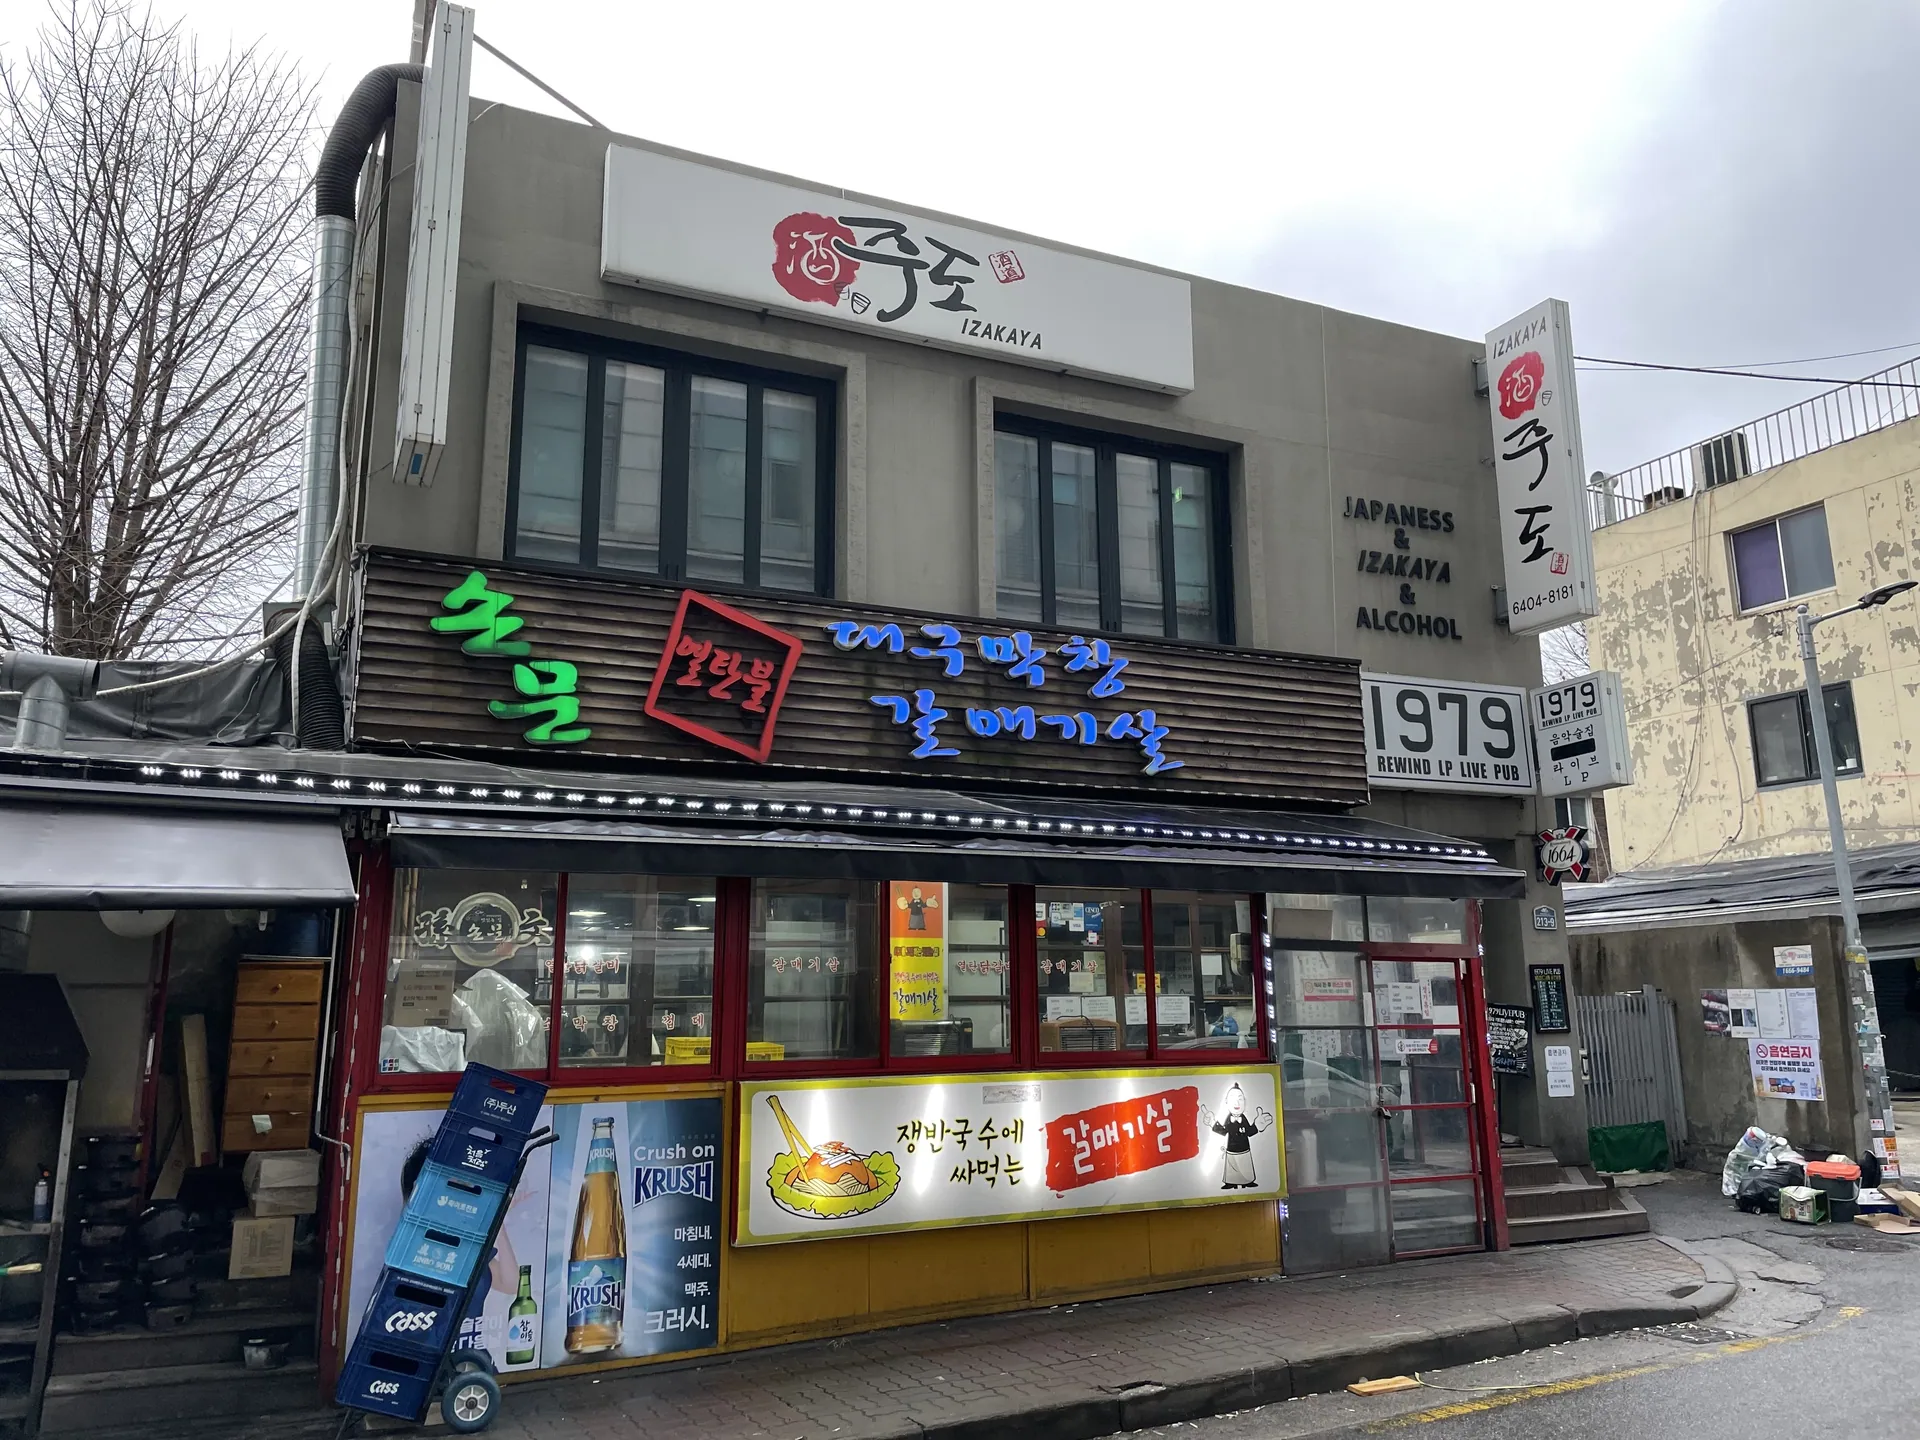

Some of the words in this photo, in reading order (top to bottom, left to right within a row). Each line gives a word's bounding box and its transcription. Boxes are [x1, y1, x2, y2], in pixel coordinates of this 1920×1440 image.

[961, 318, 1043, 351] IZAKAYA
[1493, 316, 1547, 359] IZAKAYA
[1343, 496, 1455, 533] JAPANESS
[1394, 528, 1410, 550] &
[1357, 550, 1451, 583] IZAKAYA
[1400, 583, 1416, 605] &
[1512, 583, 1575, 616] 6404-8181
[1356, 606, 1462, 640] ALCOHOL
[1539, 682, 1596, 719] 1979
[1573, 711, 1584, 719] LIVE
[1586, 707, 1597, 716] PUB
[869, 688, 1186, 776] 갈매기살
[1370, 685, 1516, 759] 1979
[1549, 724, 1594, 746] 음악술집
[1377, 755, 1431, 775] REWIND
[1438, 760, 1453, 777] LP
[1460, 761, 1487, 780] LIVE
[1494, 763, 1520, 781] PUB
[1553, 755, 1599, 773] 라이브
[1547, 845, 1576, 864] 1664
[1536, 917, 1555, 927] 213-9
[772, 956, 841, 974] 갈매기살
[1040, 958, 1098, 975] 갈매기살
[893, 987, 941, 1015] 갈매기살
[1769, 1045, 1812, 1058] 흡연금지
[483, 1097, 517, 1116] (주)두산
[896, 1117, 1025, 1156] 쟁반국수에
[1062, 1097, 1175, 1176] 갈매기살
[589, 1147, 615, 1163] KRUSH
[634, 1143, 686, 1161] Crush
[691, 1145, 715, 1158] on
[633, 1160, 714, 1208] KRUSH
[949, 1157, 1026, 1189] 싸먹는
[674, 1225, 713, 1242] 마침내.
[677, 1253, 712, 1269] 4세대.
[569, 1280, 622, 1316] KRUSH
[684, 1281, 711, 1297] 맥주.
[644, 1304, 710, 1334] 크러시.
